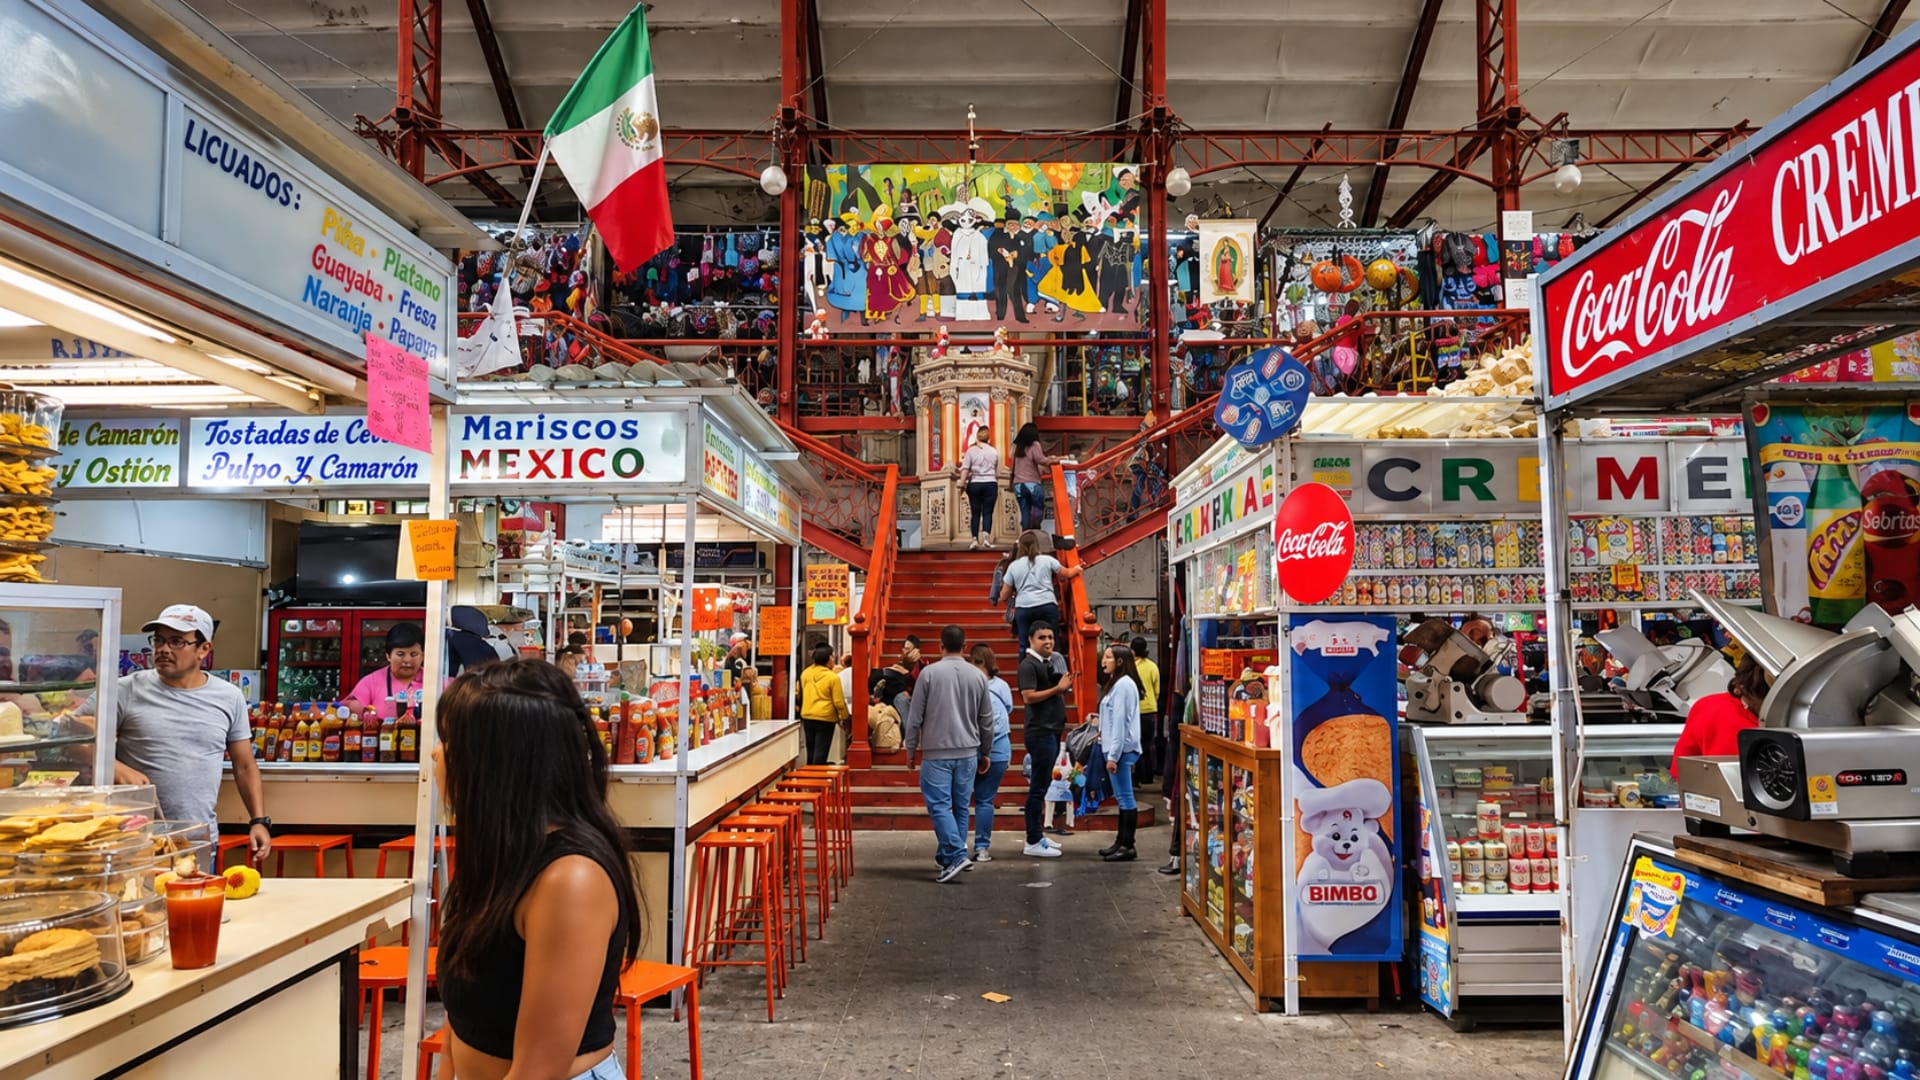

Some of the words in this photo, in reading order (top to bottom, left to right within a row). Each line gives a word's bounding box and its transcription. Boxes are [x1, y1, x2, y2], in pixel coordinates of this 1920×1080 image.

[311, 243, 384, 303] Guayaba
[1561, 180, 1743, 378] Coca-Cola
[302, 274, 372, 335] Naranja
[389, 317, 438, 360] Papaya
[85, 421, 179, 447] Camarón
[204, 418, 311, 447] Tostadas
[314, 420, 340, 445] de
[462, 413, 640, 442] Mariscos
[85, 456, 172, 484] Ostión
[201, 451, 282, 485] Pulpo
[319, 453, 419, 481] Camarón
[459, 447, 646, 481] MEXICO
[1308, 885, 1378, 902] BIMBO
